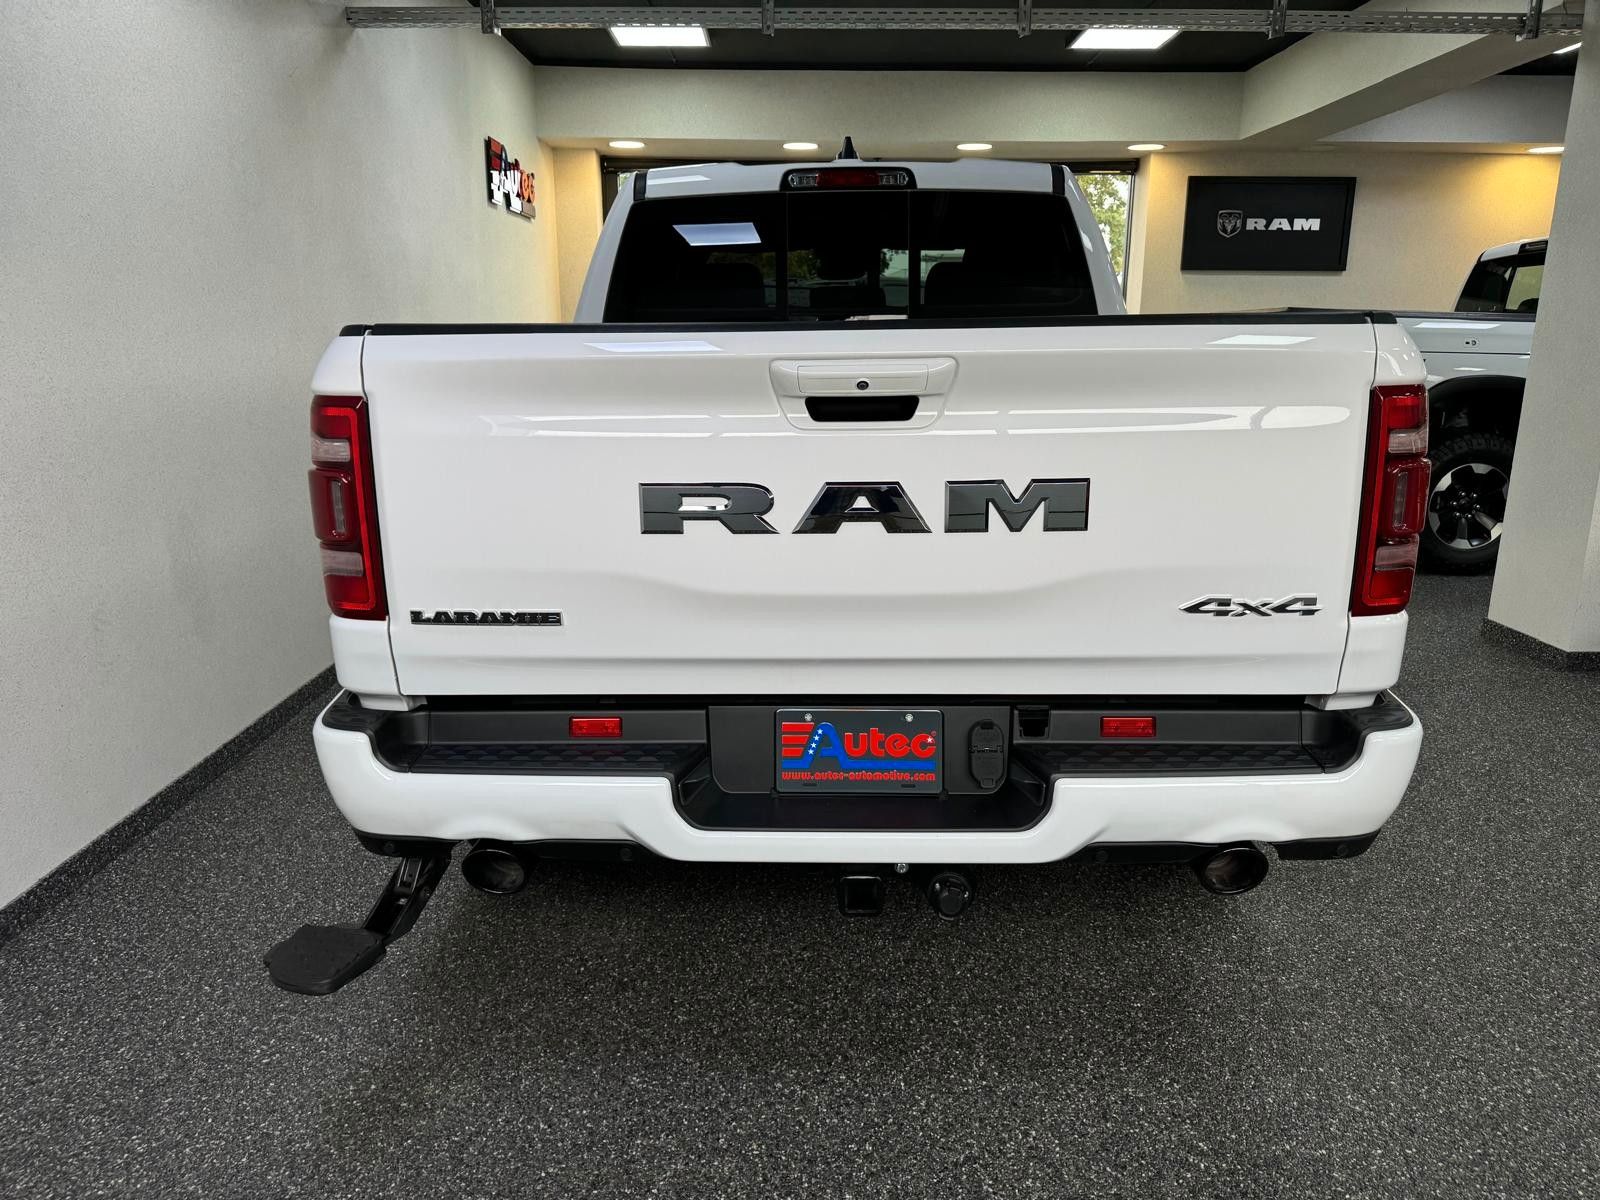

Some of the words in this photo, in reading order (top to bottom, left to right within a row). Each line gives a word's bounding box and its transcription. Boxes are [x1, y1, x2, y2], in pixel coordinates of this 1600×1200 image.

[1245, 218, 1321, 231] RAM
[638, 478, 1091, 534] RAM
[1178, 594, 1322, 617] 4x4
[410, 609, 562, 626] LARAMIE
[802, 721, 937, 769] Autec
[781, 770, 936, 781] www.autec-automotive.com
